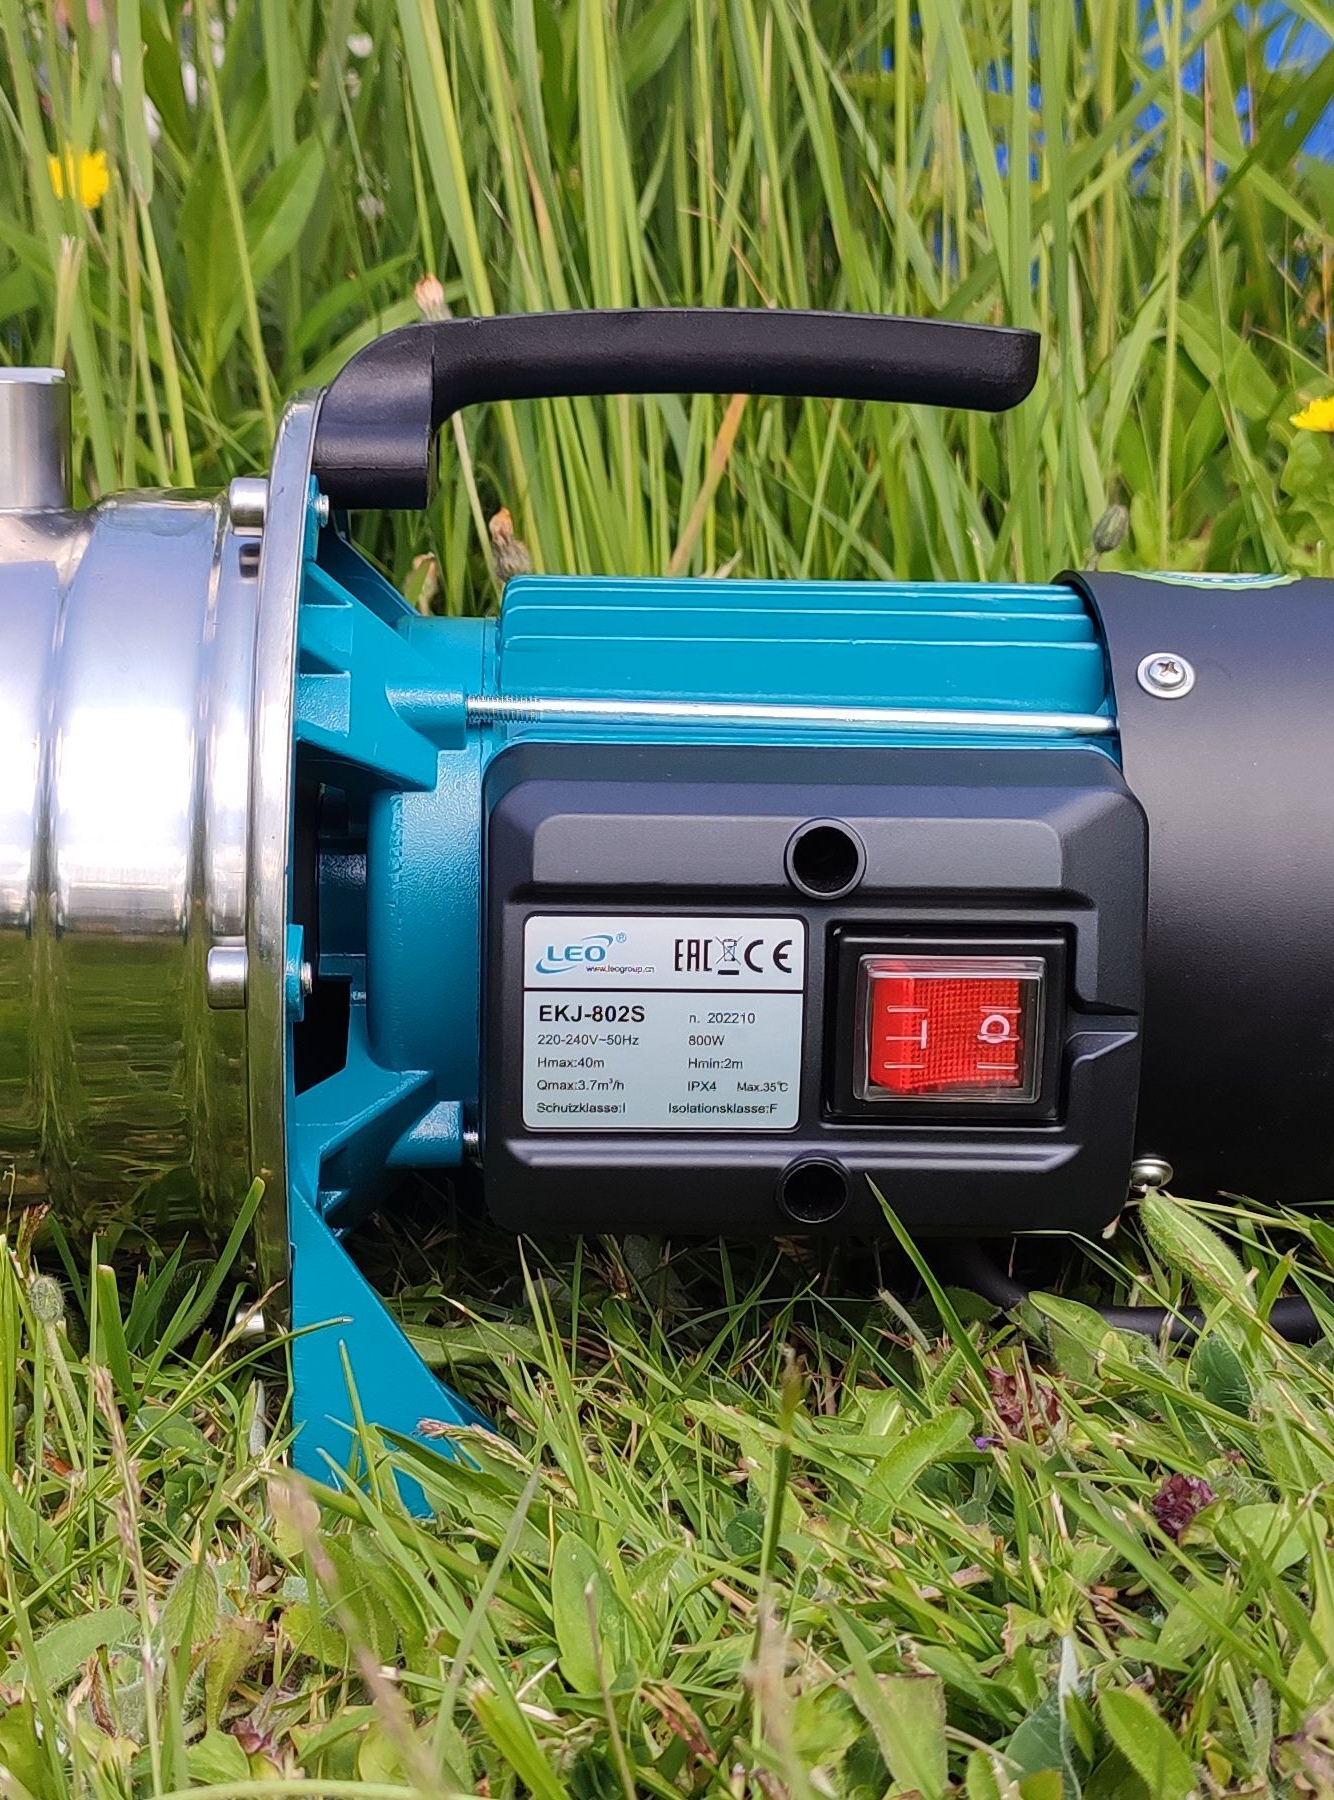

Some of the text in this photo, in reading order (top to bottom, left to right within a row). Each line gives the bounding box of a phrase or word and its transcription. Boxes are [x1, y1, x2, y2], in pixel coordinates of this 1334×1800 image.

[546, 945, 607, 962] LEO
[586, 965, 655, 975] www.leogroup.cn
[539, 1005, 645, 1023] EKJ-802S
[707, 1012, 756, 1025] 202210
[537, 1034, 639, 1047] 220-240V~50Hz
[688, 1035, 725, 1046] 800W
[537, 1057, 605, 1069] Hmax:40m
[688, 1058, 743, 1070] Hmin:2m
[687, 1081, 717, 1093] IPX4
[536, 1101, 626, 1114] Schutzklasse:I
[668, 1102, 778, 1115] Isolationsklasse:F
